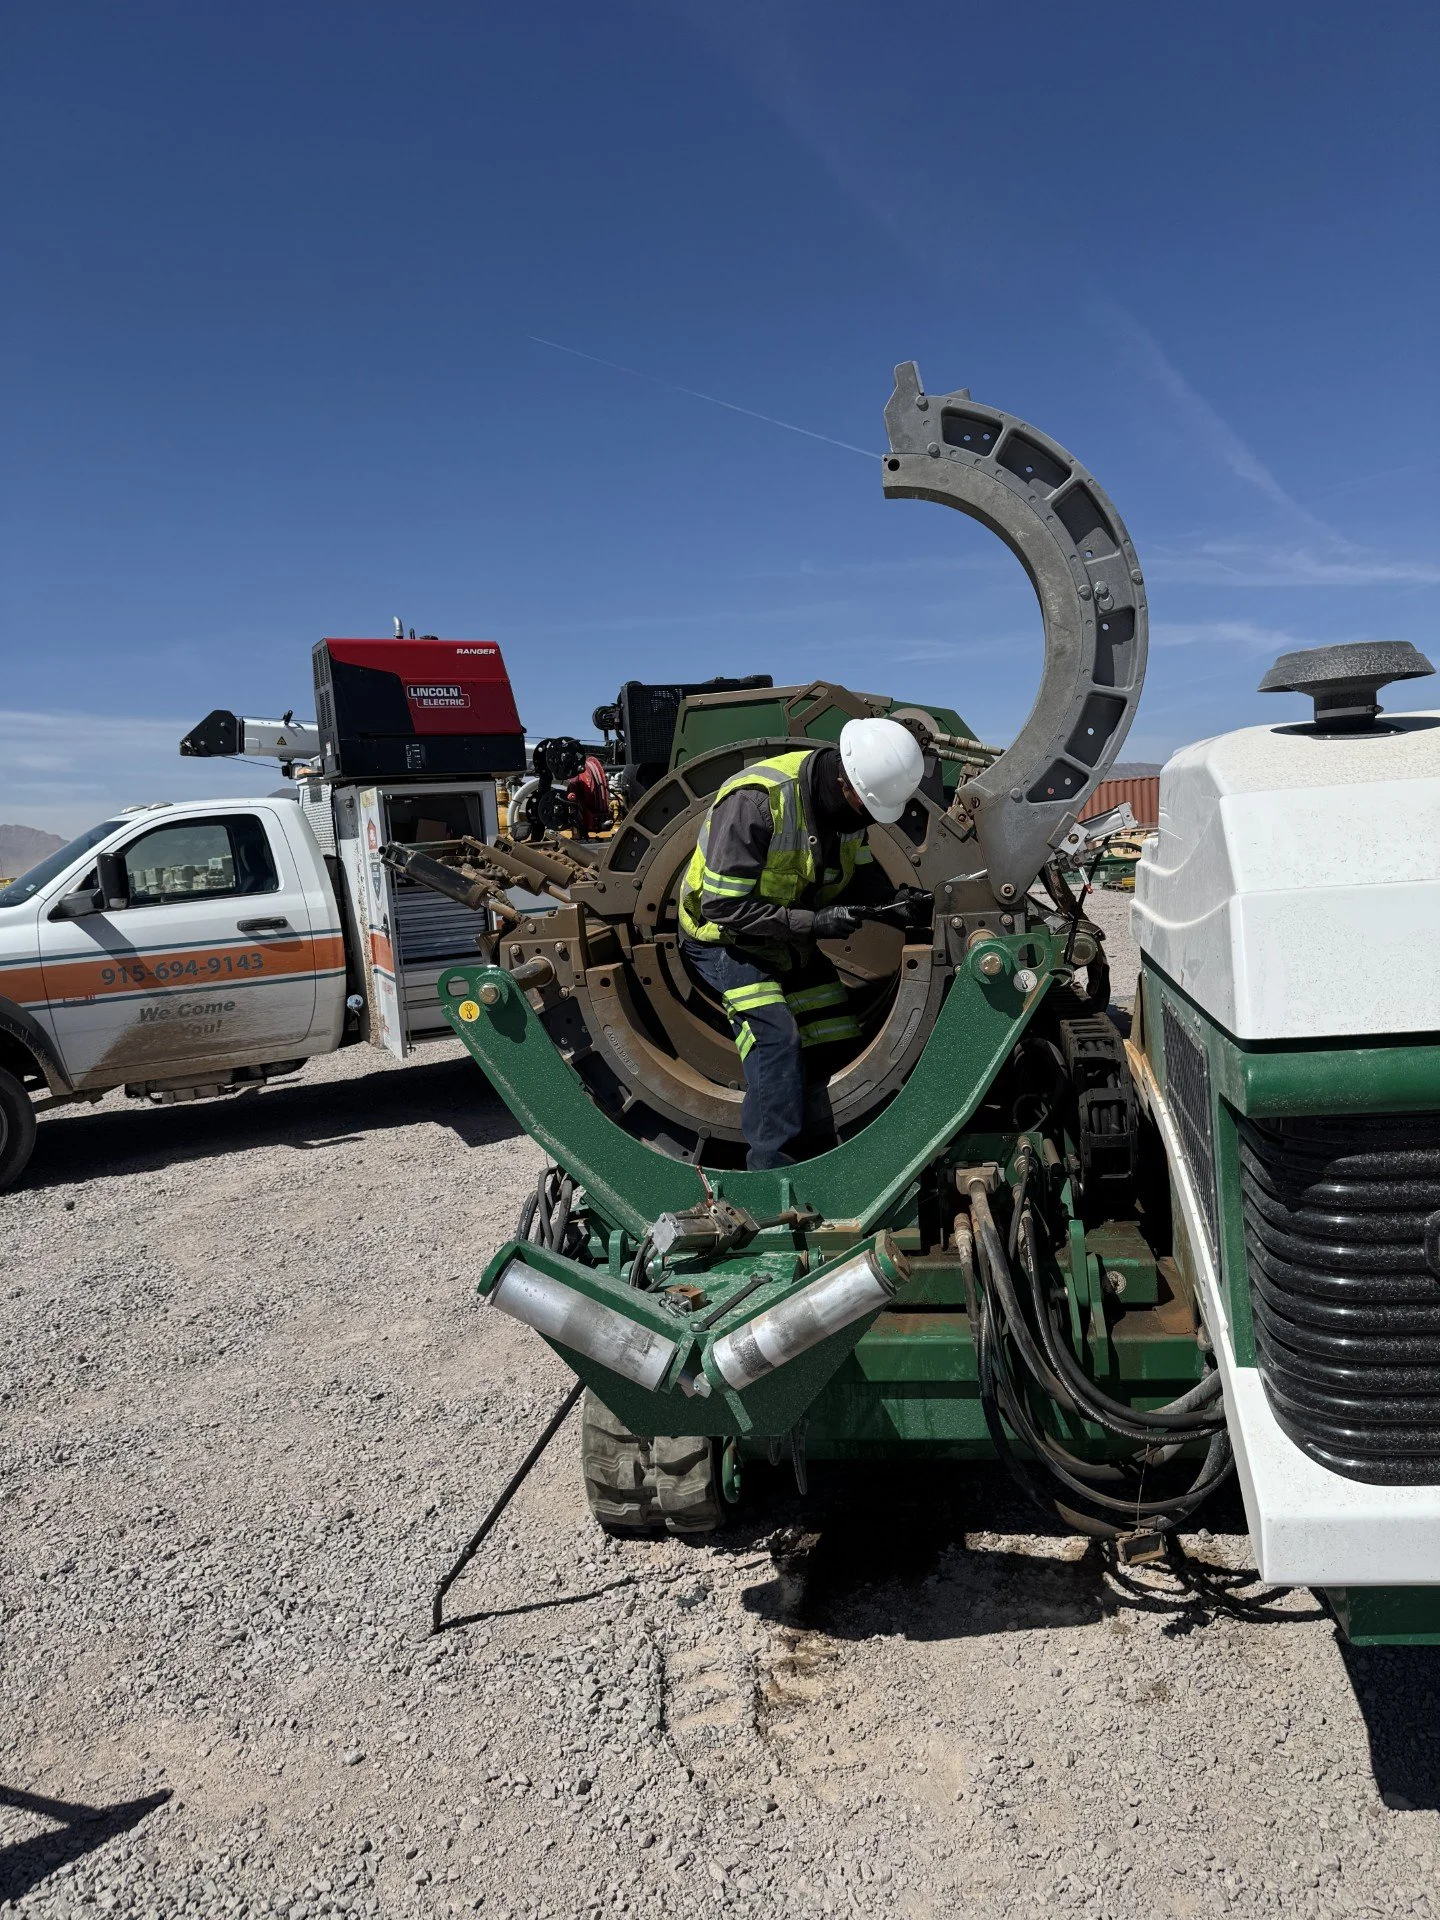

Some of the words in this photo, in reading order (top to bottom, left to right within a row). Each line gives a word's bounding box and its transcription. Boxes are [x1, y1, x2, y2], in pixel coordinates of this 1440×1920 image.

[410, 687, 459, 697] LINCOLN
[423, 698, 465, 706] ELECTRIC
[101, 953, 263, 985] 915-694-9143
[139, 1006, 172, 1022] We
[177, 1000, 236, 1017] Come
